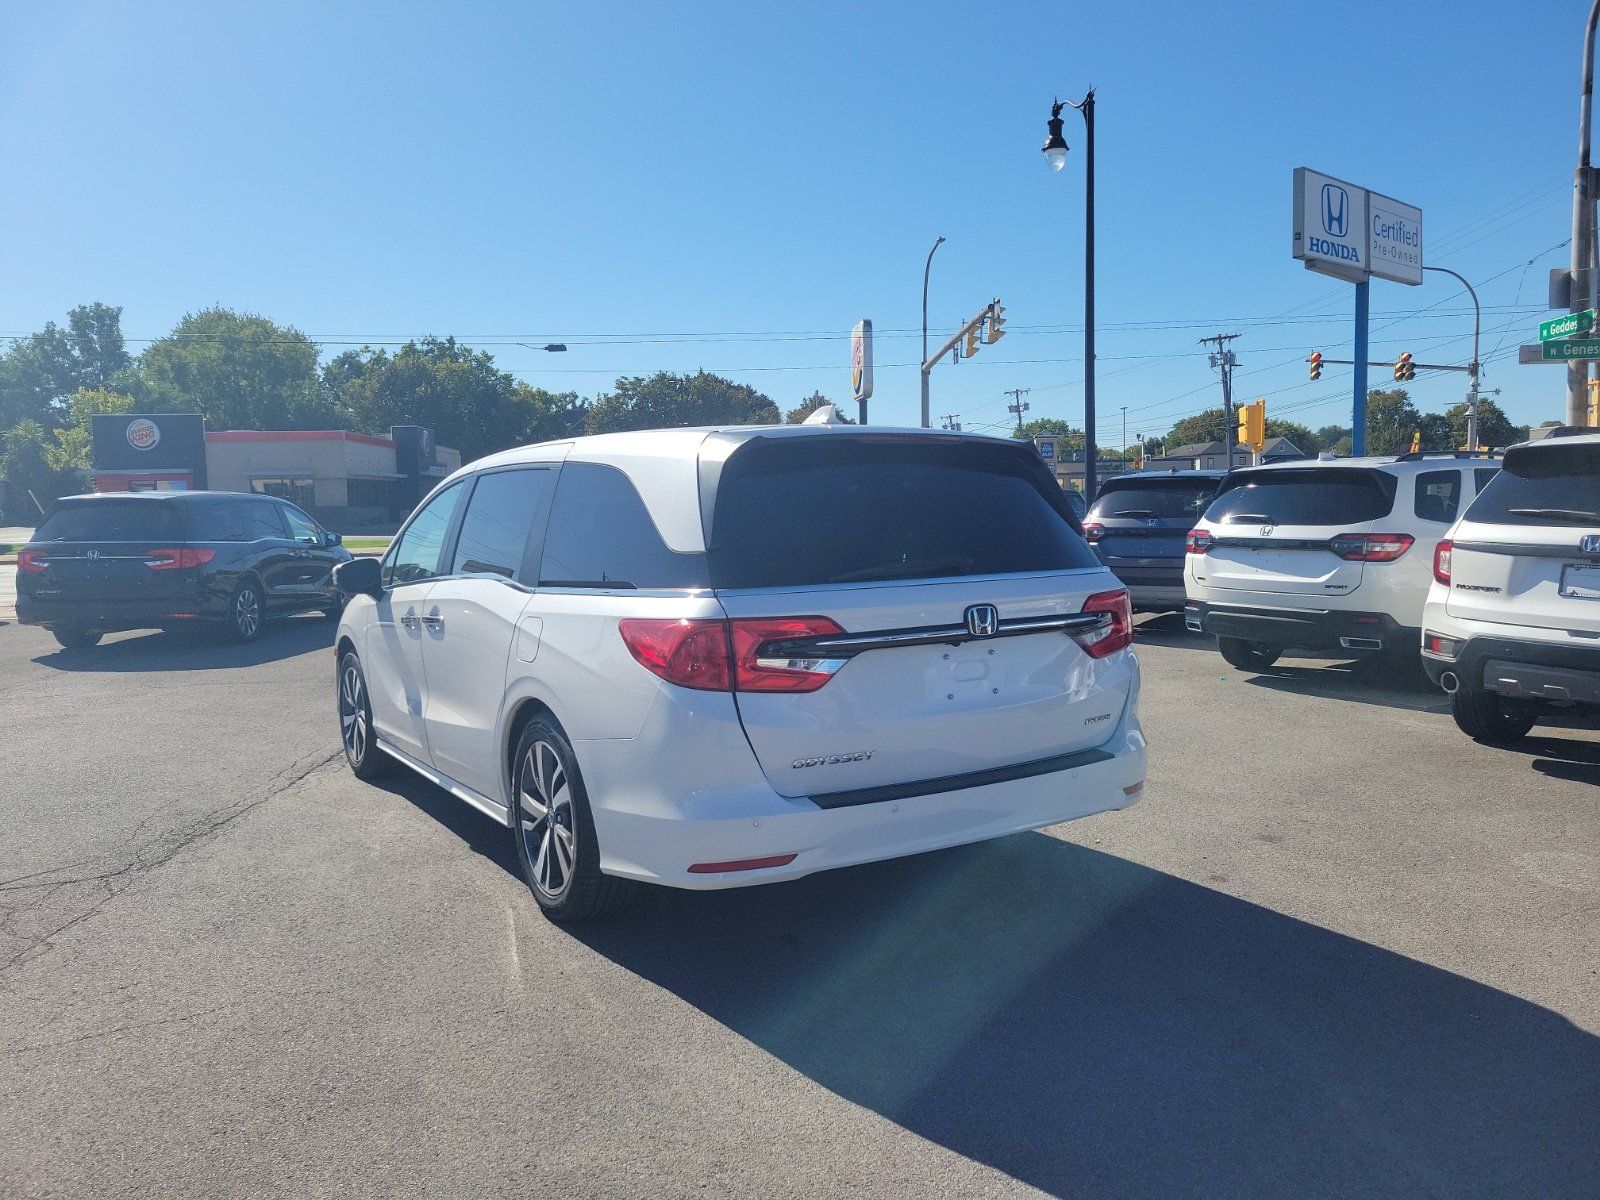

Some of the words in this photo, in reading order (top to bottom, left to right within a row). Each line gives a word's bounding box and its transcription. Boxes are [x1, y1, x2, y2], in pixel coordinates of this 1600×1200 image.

[1373, 214, 1419, 248] Certified
[1309, 236, 1360, 262] HONDA
[1373, 240, 1418, 265] Pre-Owned
[1542, 329, 1548, 337] N
[1550, 320, 1578, 336] Geddes
[1550, 347, 1557, 355] W
[1563, 344, 1600, 355] Genes
[130, 425, 154, 435] BURGER
[131, 431, 155, 442] KING
[1455, 583, 1502, 593] PASSPORT
[791, 750, 877, 769] ODYSSEY
